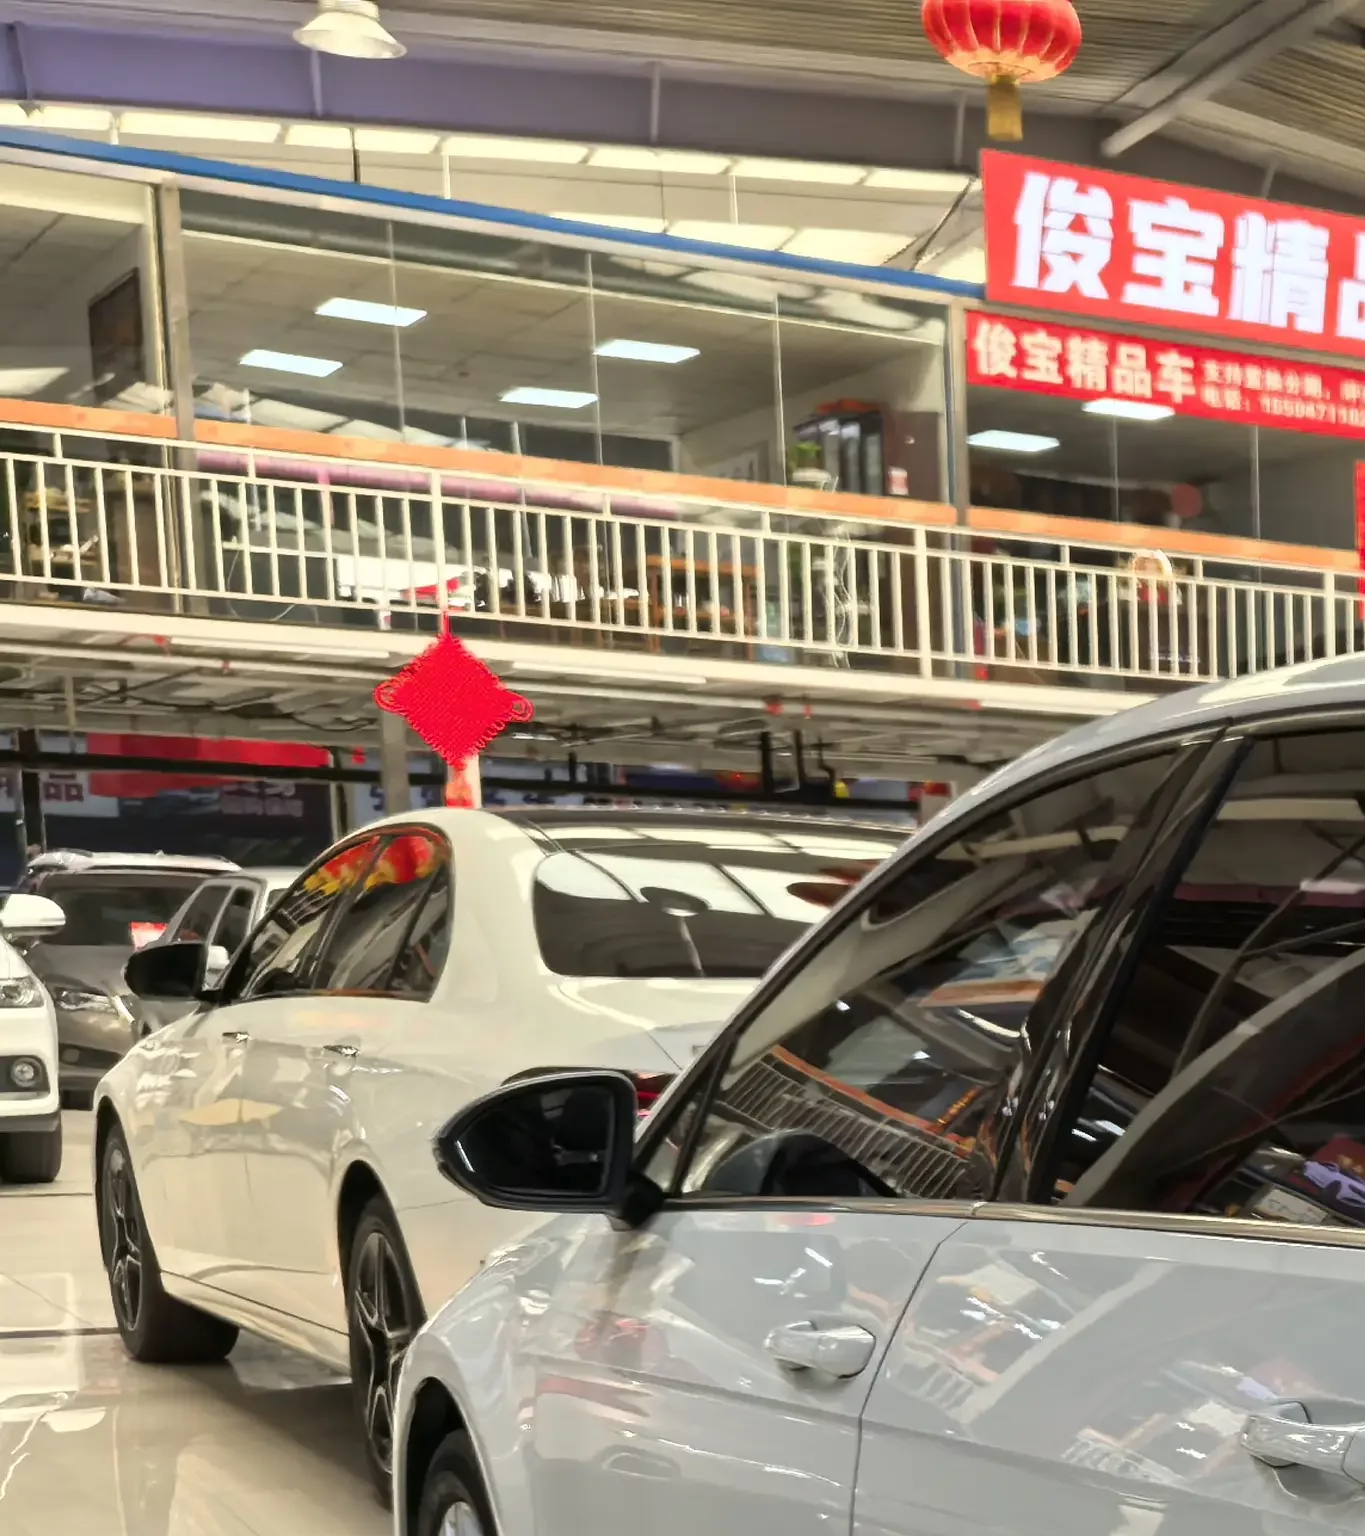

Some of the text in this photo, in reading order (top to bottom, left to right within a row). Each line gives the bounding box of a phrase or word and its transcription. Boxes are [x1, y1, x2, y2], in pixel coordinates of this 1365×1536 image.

[973, 321, 1196, 403] 俊宝精品车
